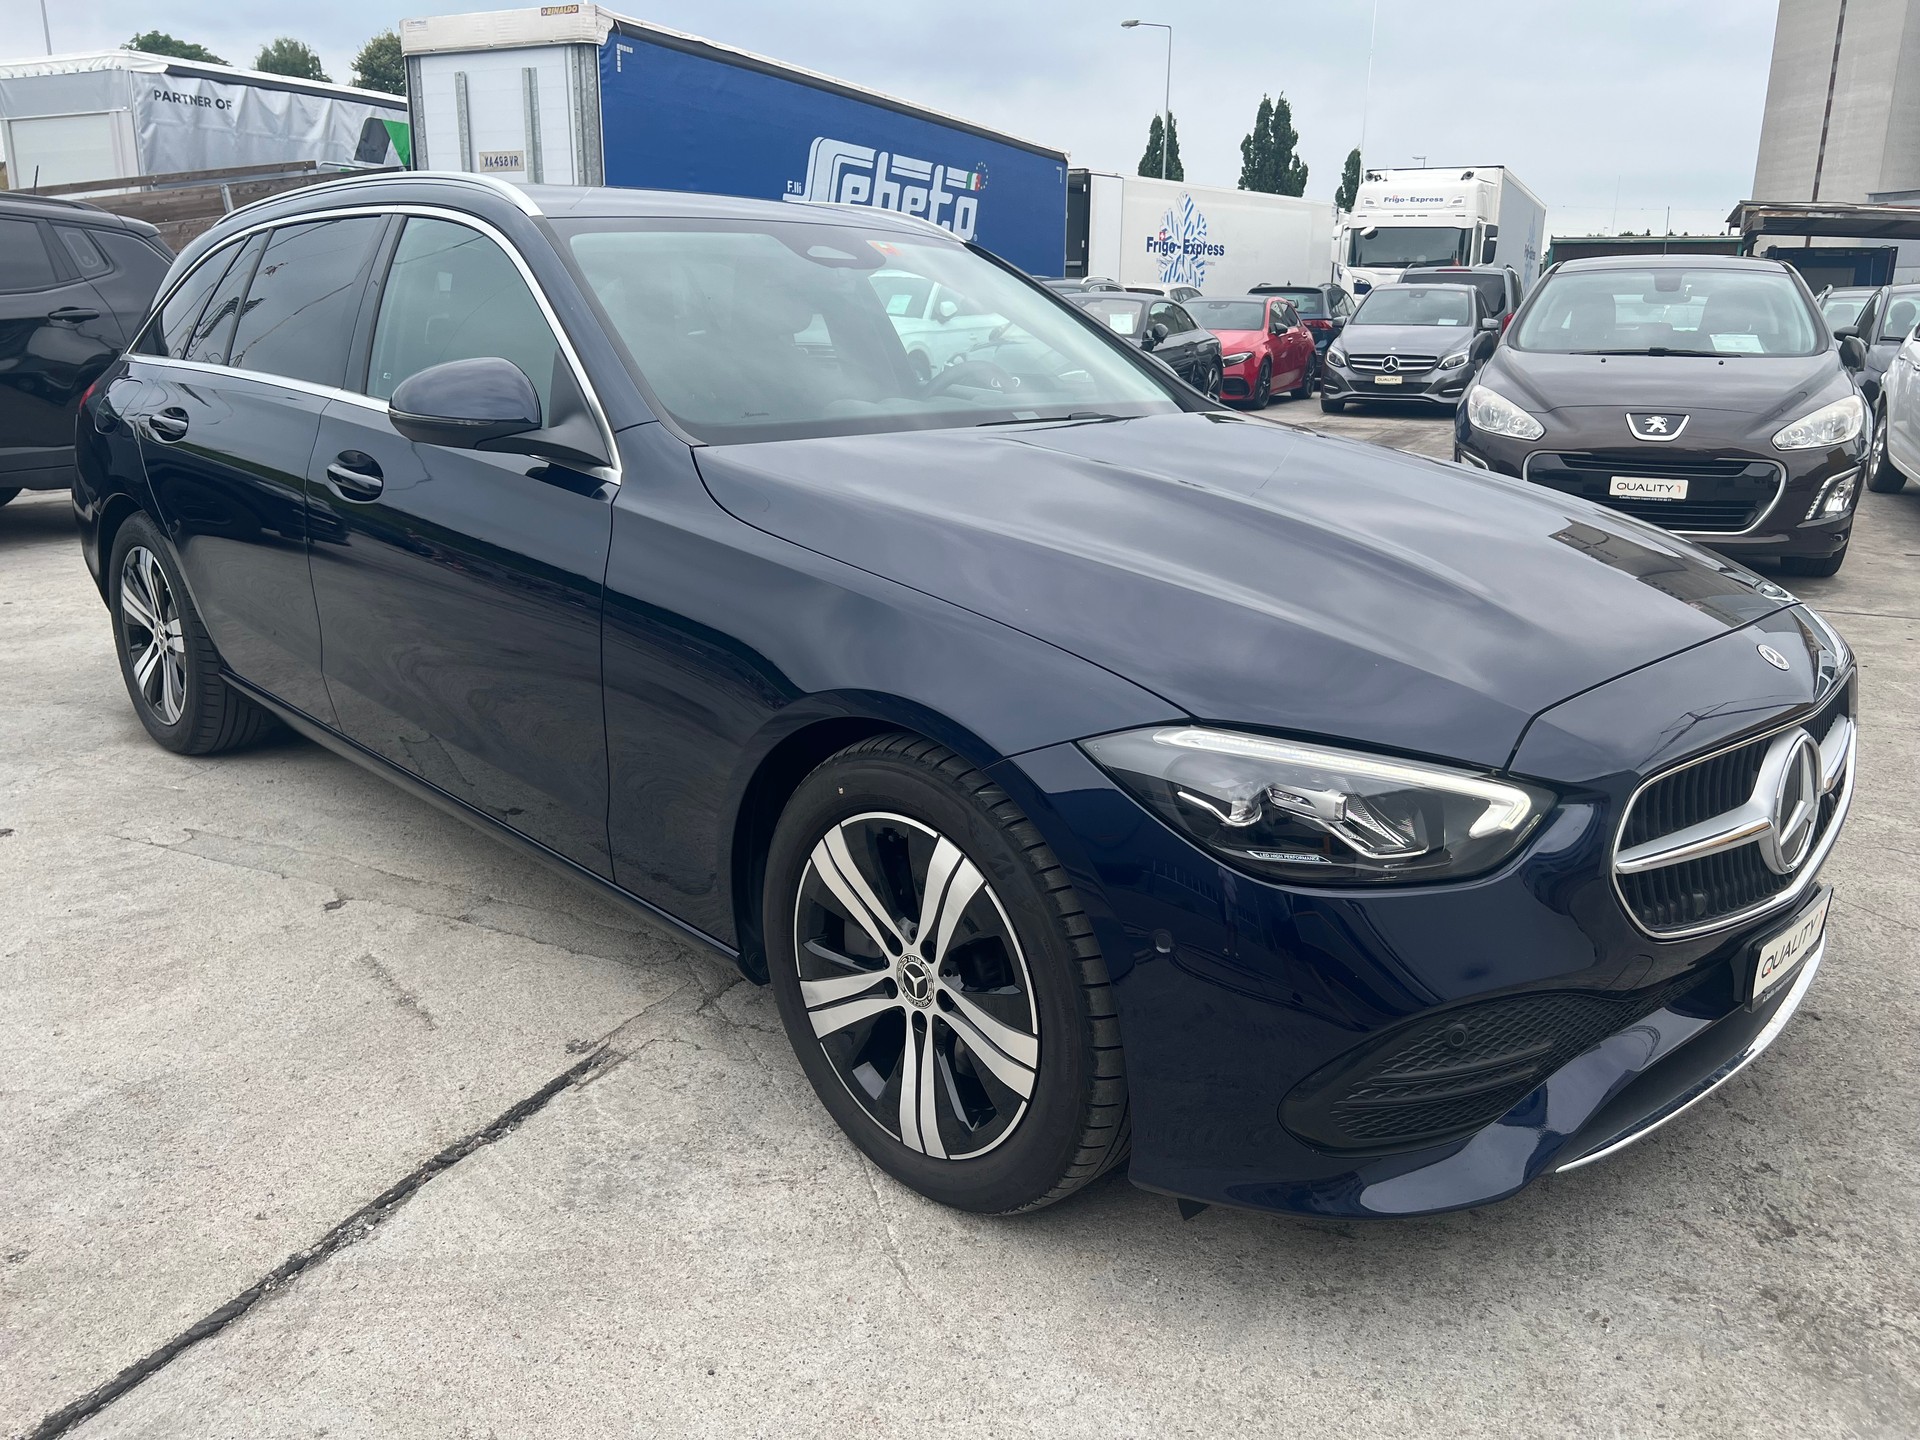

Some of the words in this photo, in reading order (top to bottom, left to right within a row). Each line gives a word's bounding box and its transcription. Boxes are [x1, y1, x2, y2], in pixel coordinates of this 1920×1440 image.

[153, 90, 212, 108] PARTNER
[215, 98, 232, 110] OF
[1616, 482, 1674, 493] QUALITY
[1761, 913, 1819, 979] QUALITY
